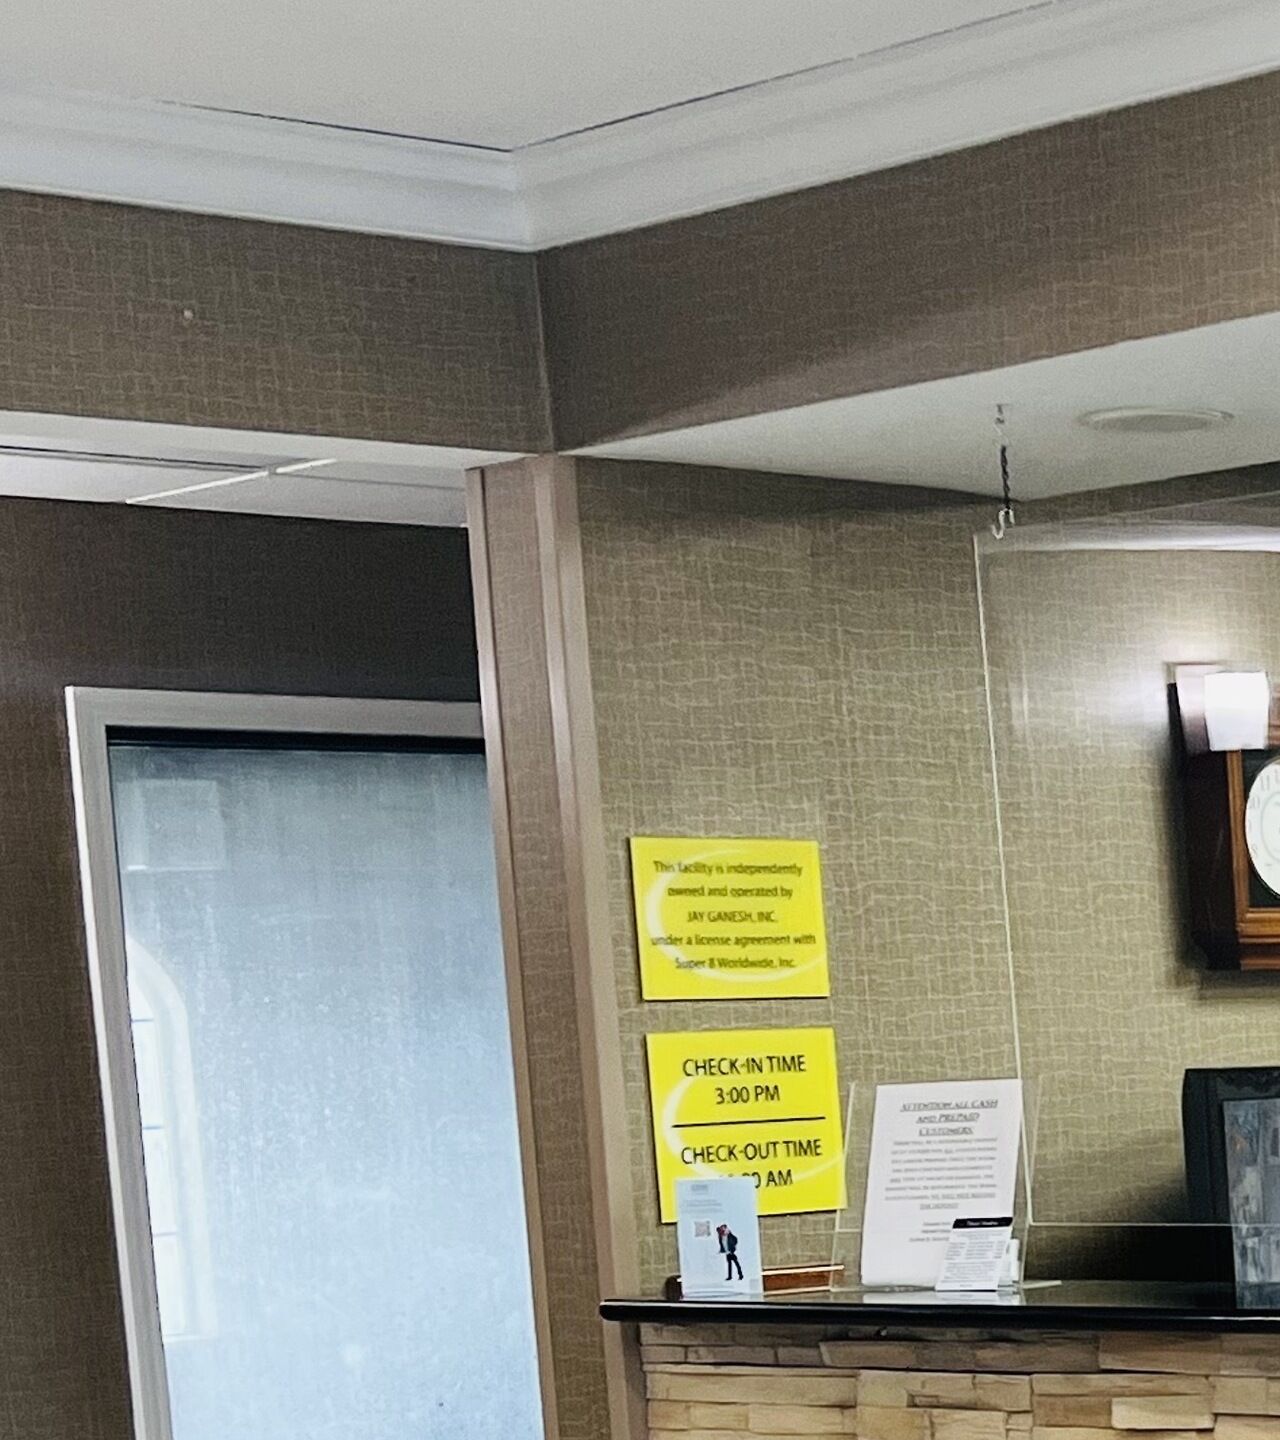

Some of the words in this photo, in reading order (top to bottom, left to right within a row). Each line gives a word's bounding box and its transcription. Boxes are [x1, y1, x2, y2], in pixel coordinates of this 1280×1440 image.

[653, 860, 675, 873] This
[678, 862, 713, 876] facility
[726, 862, 803, 877] independently
[667, 885, 704, 897] owned
[708, 885, 728, 897] and
[730, 885, 778, 899] operated
[780, 885, 793, 899] by
[687, 911, 704, 923] JAY
[651, 934, 684, 946] under
[686, 937, 692, 945] a
[695, 934, 731, 946] license
[734, 934, 792, 948] agreement
[793, 933, 816, 945] with
[675, 957, 706, 970] Super
[709, 958, 715, 969] 8
[682, 1057, 764, 1077] CHECK-IN
[766, 1055, 807, 1073] TIME
[715, 1086, 750, 1105] 3:00
[754, 1085, 780, 1102] PM
[971, 1099, 998, 1109] CASH
[938, 1112, 980, 1122] PREPAID
[681, 1142, 780, 1165] CHECK-OUT
[783, 1139, 823, 1157] TIME
[766, 1169, 793, 1188] AM
